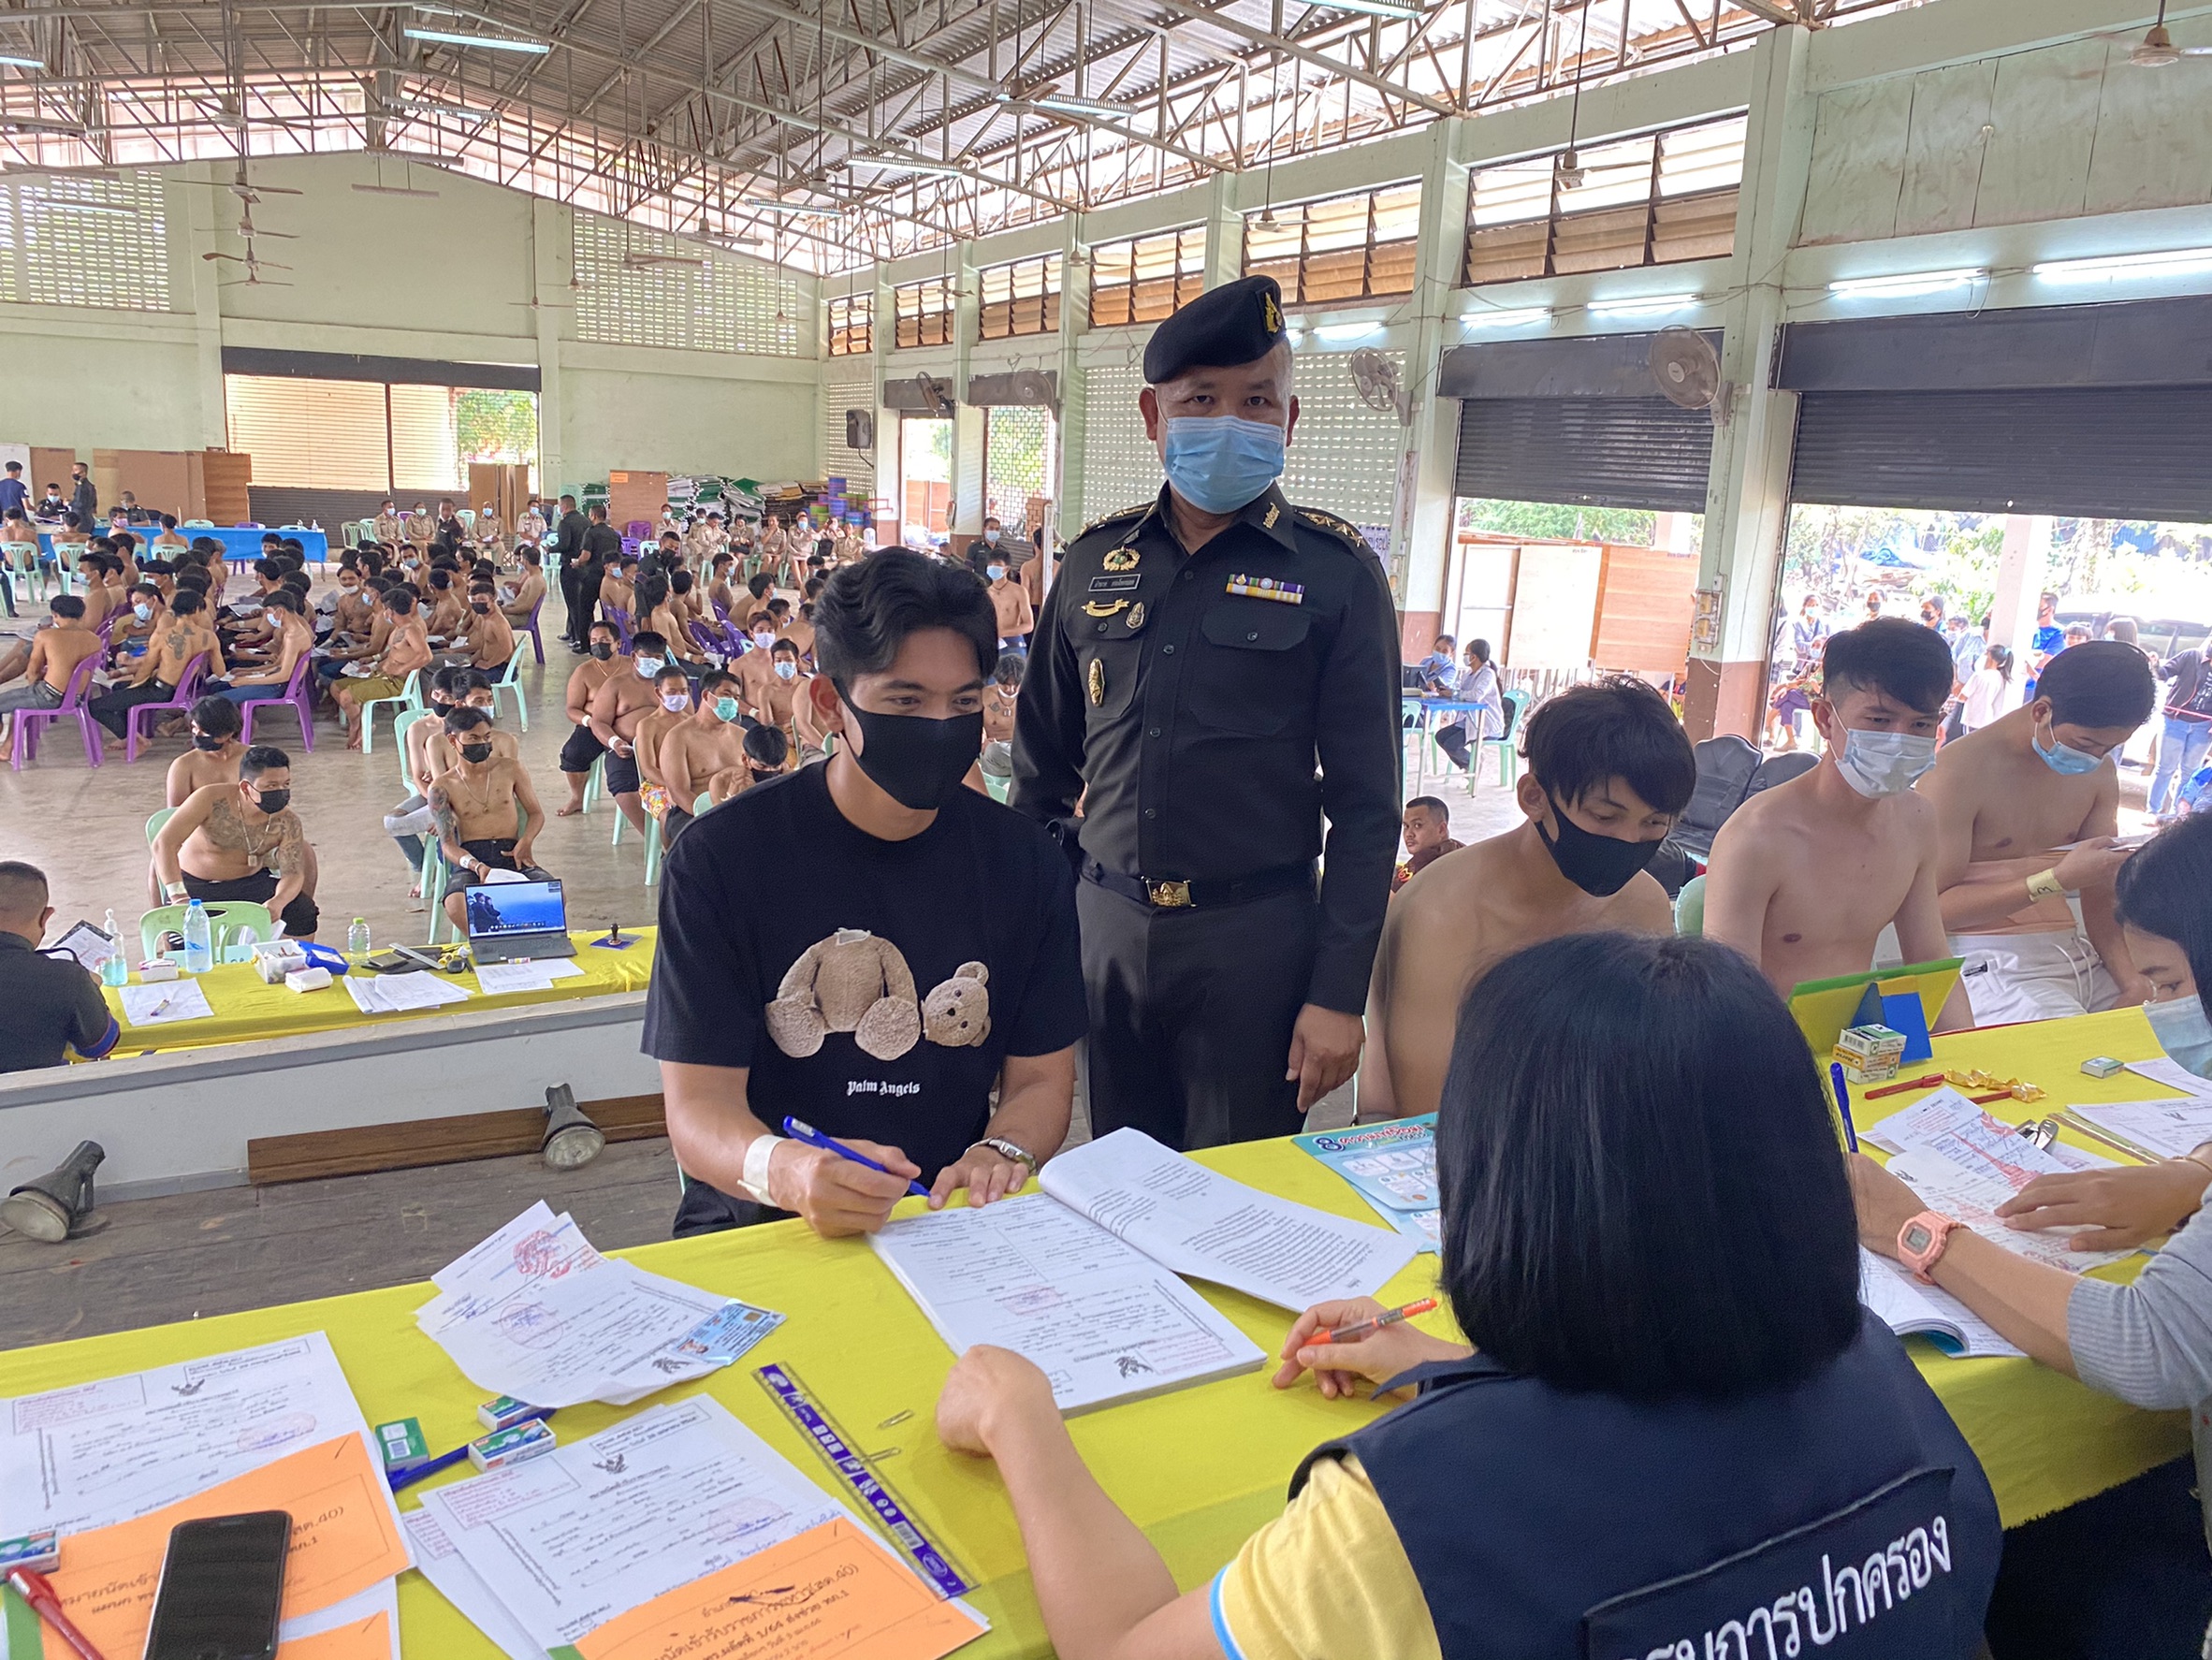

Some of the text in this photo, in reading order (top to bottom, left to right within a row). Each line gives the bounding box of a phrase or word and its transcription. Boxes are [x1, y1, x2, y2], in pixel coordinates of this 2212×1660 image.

[847, 1079, 921, 1098] Palm Angels
[1622, 1515, 1951, 1660] การปกครอง
